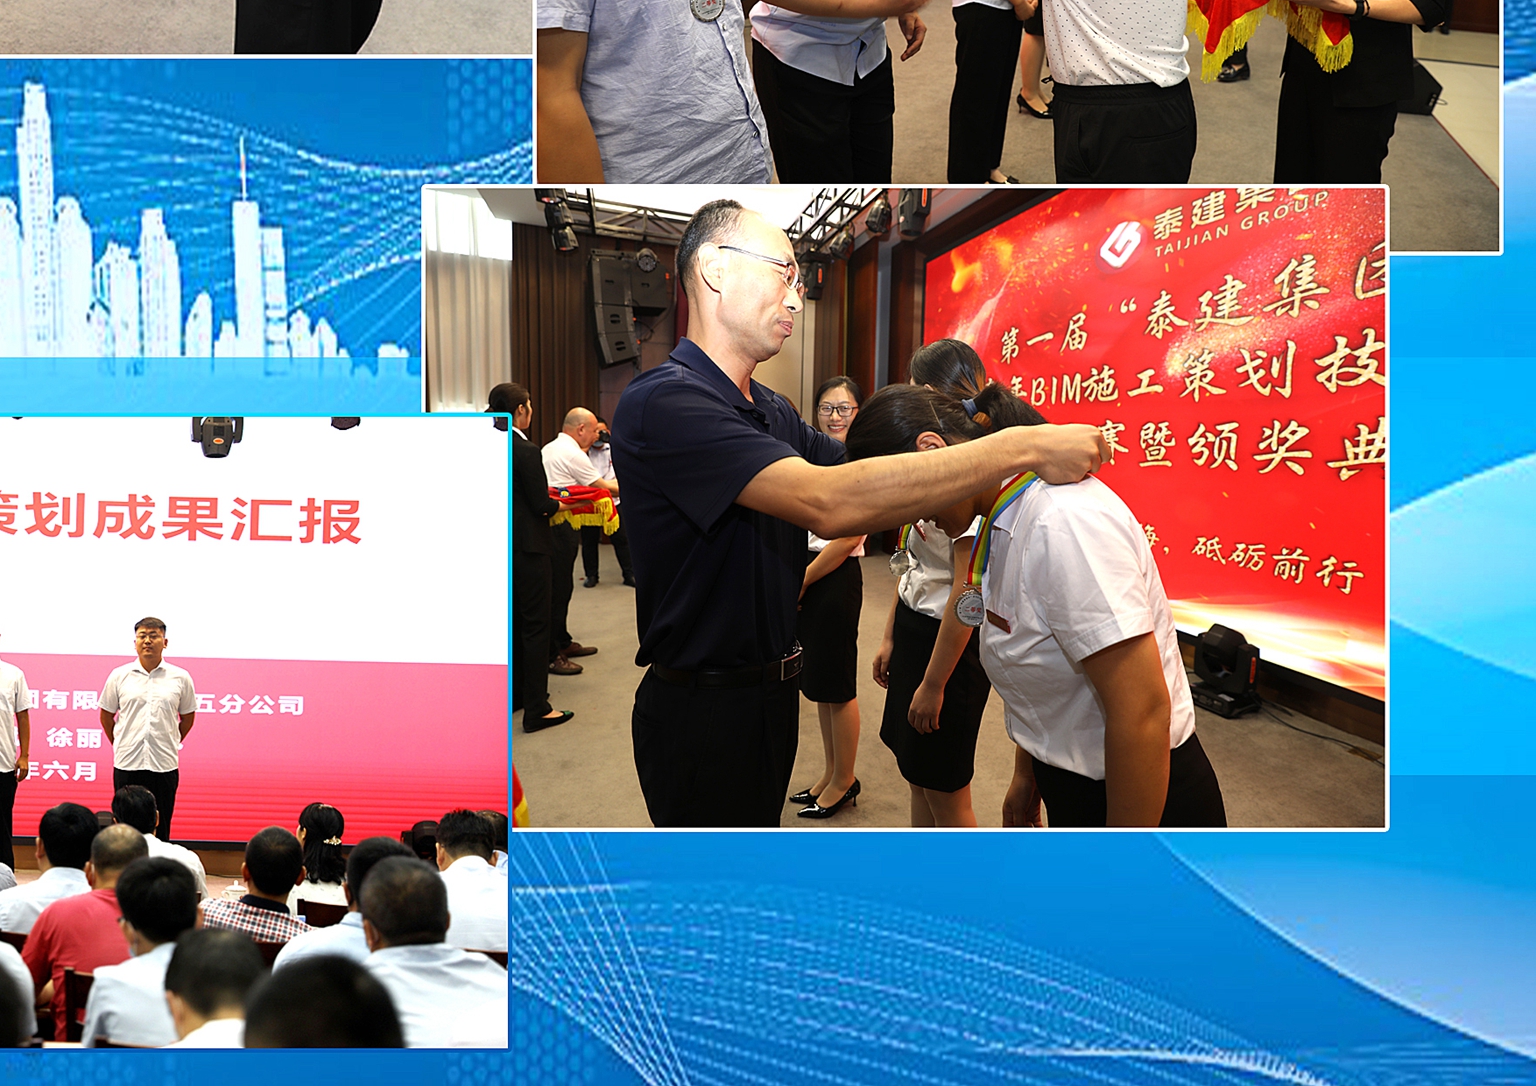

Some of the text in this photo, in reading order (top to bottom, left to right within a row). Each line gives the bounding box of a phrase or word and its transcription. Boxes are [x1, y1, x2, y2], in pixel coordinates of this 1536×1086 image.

[1153, 188, 1308, 241] 泰建集
[1154, 190, 1330, 257] TAIJIAN GROUP
[985, 328, 1385, 407] 年BIM施工策划技
[1000, 312, 1088, 365] 第一届
